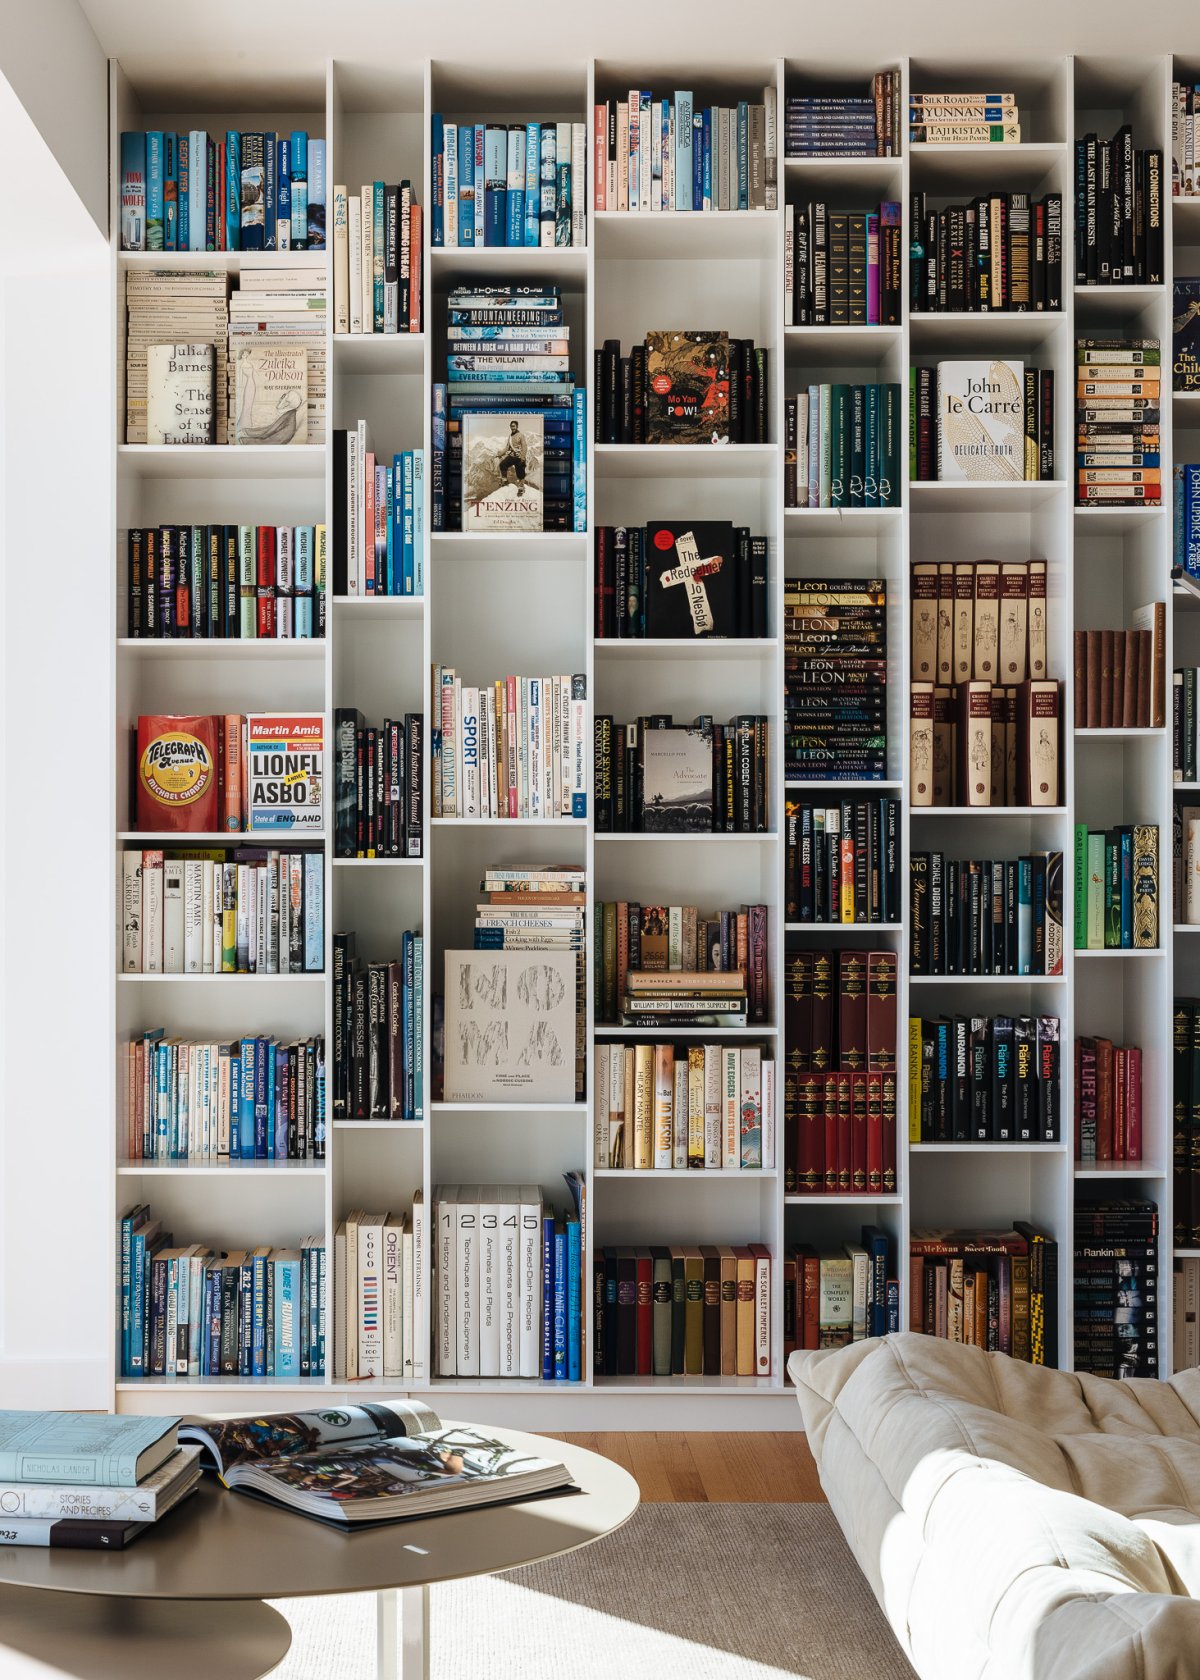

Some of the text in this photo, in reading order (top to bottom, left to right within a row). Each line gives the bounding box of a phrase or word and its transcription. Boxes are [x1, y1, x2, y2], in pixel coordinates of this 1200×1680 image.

[924, 96, 969, 104] SILK ROAD
[924, 108, 984, 117] YUNNAN
[928, 126, 989, 136] TAJIKISTAN
[179, 140, 188, 192] GEOFF DYER
[447, 128, 456, 200] MIRACLE ANDES
[528, 126, 536, 190] ANTARCTICA 2041
[1087, 142, 1095, 246] THE LAST RAIN FORESTS
[1150, 169, 1159, 227] CONNECTIONS
[471, 311, 540, 321] MOUNTAINEERING
[168, 361, 212, 373] Barnes
[1178, 353, 1196, 361] The
[265, 371, 304, 381] Dobson
[963, 378, 1001, 397] John
[188, 390, 211, 401] The
[948, 396, 1020, 413] le Carré
[175, 404, 212, 415] Sense
[668, 407, 697, 416] POW!
[179, 422, 194, 430] of
[955, 445, 1013, 455] DELICATE TRUTH
[472, 501, 538, 518] TENZING
[1190, 469, 1200, 539] JOHN UPDIKE
[682, 551, 700, 562] The
[179, 559, 187, 584] Connelly
[671, 561, 722, 580] Redeemer
[691, 584, 702, 595] Jo
[797, 581, 827, 591] Leon
[692, 596, 706, 628] Nesbø
[793, 619, 834, 631] LEON
[800, 633, 830, 642] Leon
[252, 725, 320, 735] Martin Amis
[443, 687, 454, 797] Chronicle OLYMPICS
[464, 716, 477, 767] SPORT
[147, 741, 207, 766] TELEGRAPH
[159, 757, 194, 768] Avenue
[253, 754, 322, 775] LIONEL
[341, 721, 354, 783] SPORTSCAPE
[411, 719, 420, 823] Aerobics Instructor Manual
[147, 774, 207, 800] MICHAEL CHABON
[253, 782, 306, 803] ASBO
[254, 815, 268, 823] State
[912, 878, 926, 931] Renegade
[356, 980, 364, 1058] UNDER PRESSURE
[246, 1044, 254, 1100] BORN TO RUN
[910, 1044, 918, 1080] RANKIN
[975, 1047, 984, 1080] Rankin
[998, 1044, 1008, 1078] Rankin
[1019, 1044, 1029, 1078] Rankin
[1042, 1045, 1053, 1078] Rankin
[1082, 1069, 1095, 1096] LIFE
[1082, 1101, 1095, 1142] APART
[461, 1214, 475, 1229] 2
[483, 1215, 497, 1229] 3
[503, 1215, 518, 1229] 4
[524, 1215, 538, 1230] 5
[387, 1233, 397, 1283] ORIENT
[463, 1237, 471, 1288] Techniques
[506, 1238, 514, 1288] Ingredients
[526, 1238, 534, 1292] Plated-Dish
[255, 1260, 264, 1326] RUNNING ON EMPTY
[442, 1214, 451, 1359] 1 History and Fundamentals
[876, 1256, 884, 1307] BESTIARY
[282, 1268, 293, 1347] LORE OF RUNNING
[463, 1311, 471, 1360] Equipment
[506, 1312, 514, 1372] Preparations
[60, 1495, 91, 1504] STORIES
[60, 1505, 111, 1515] AND RECIPES
